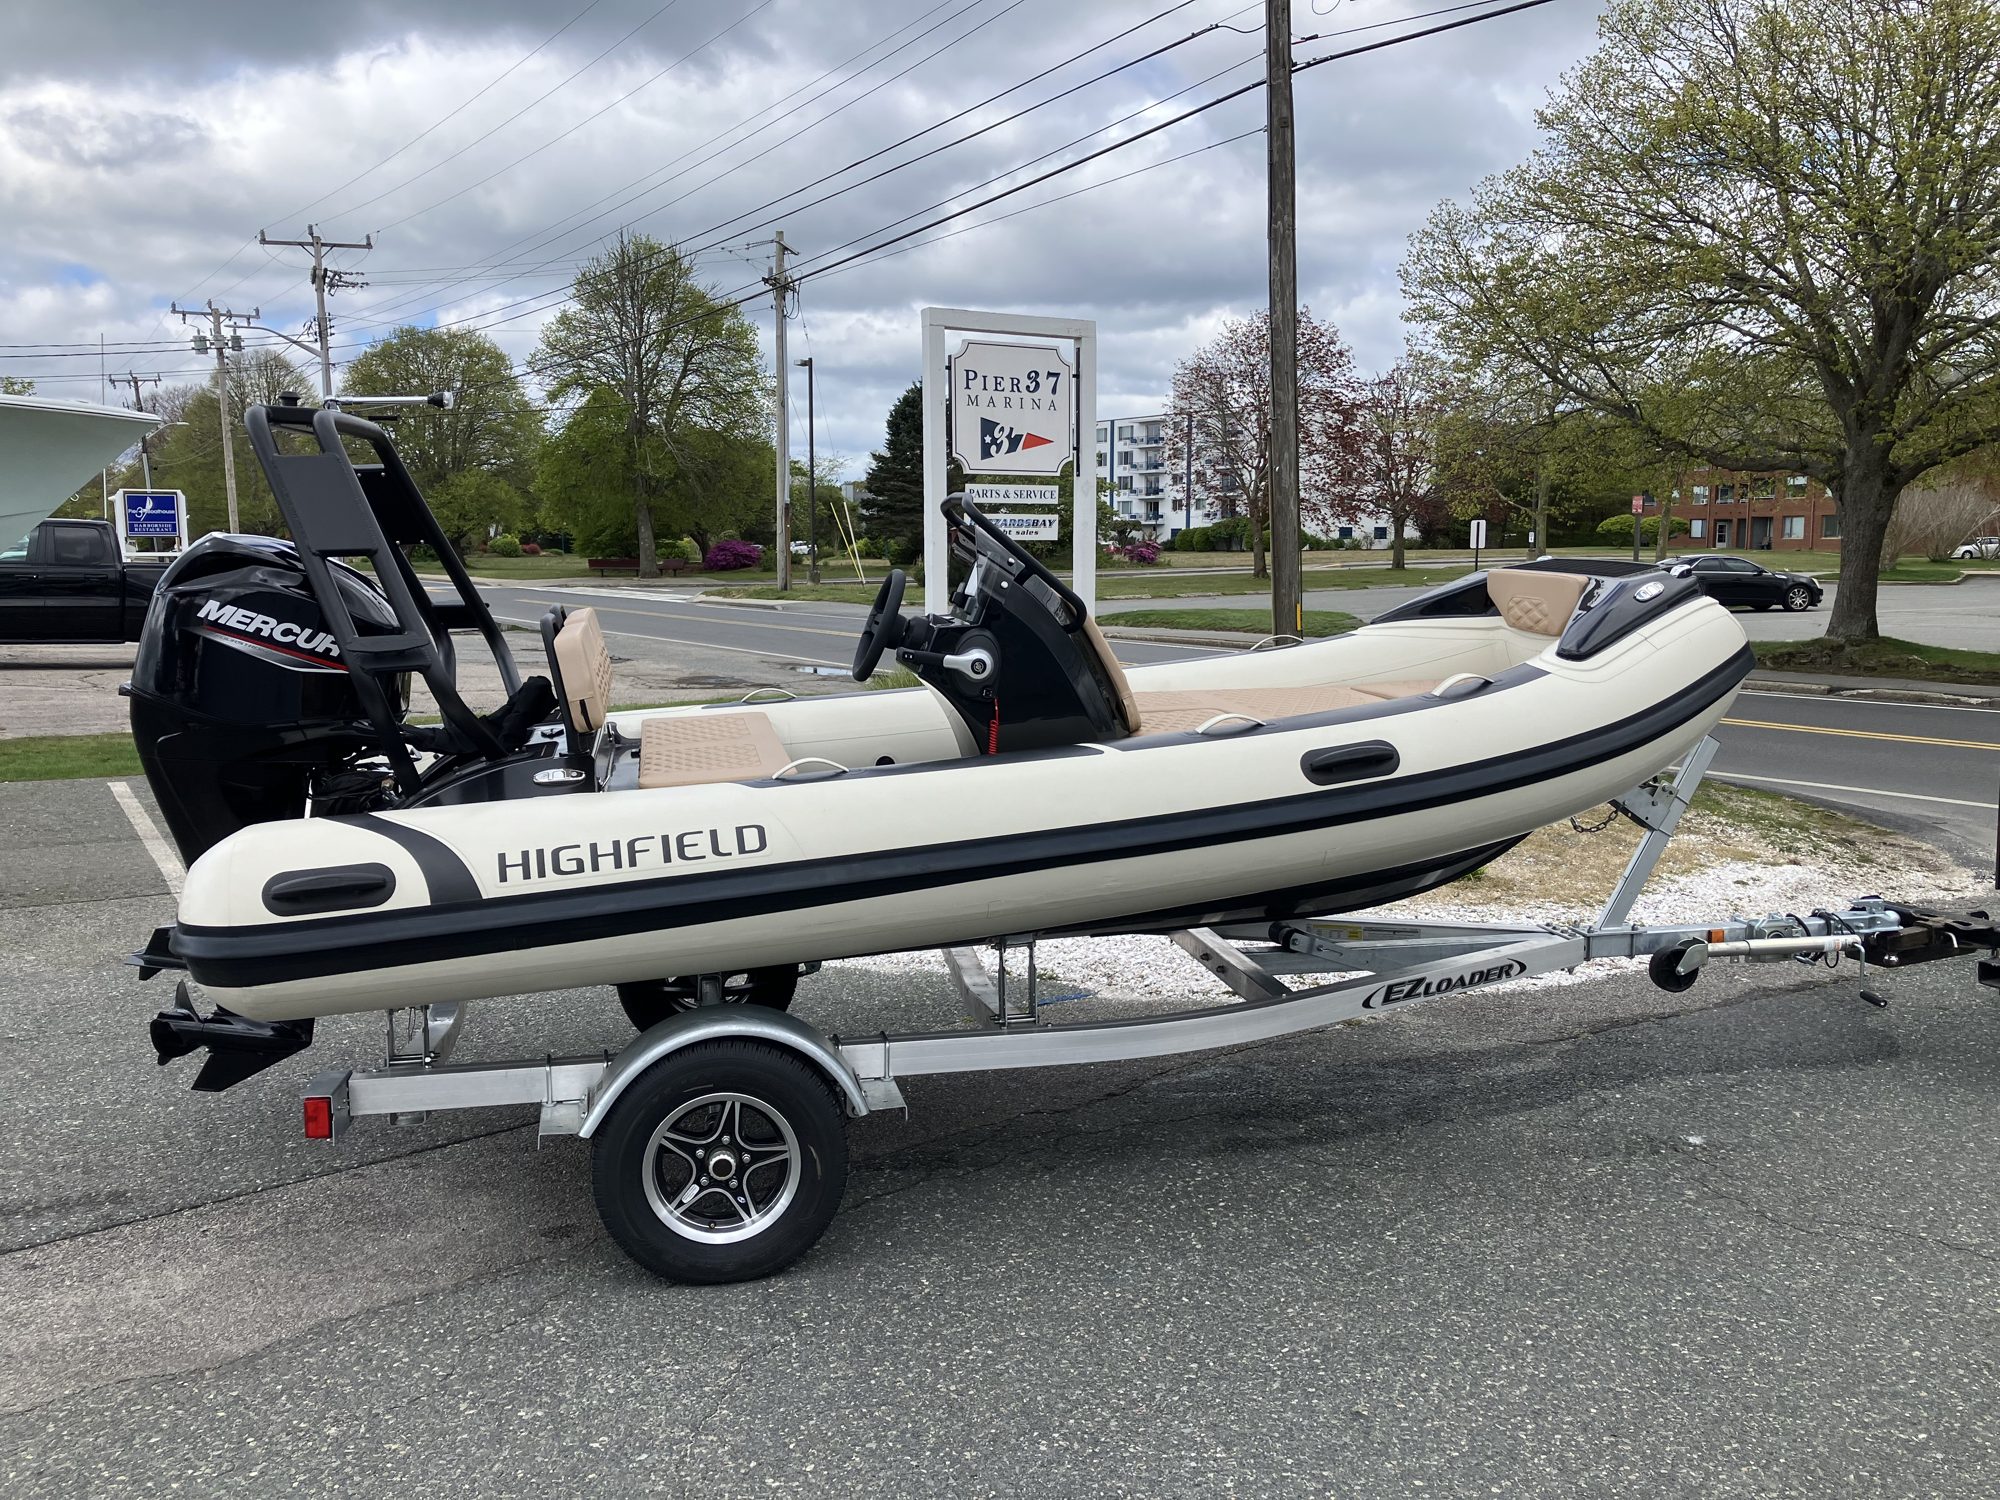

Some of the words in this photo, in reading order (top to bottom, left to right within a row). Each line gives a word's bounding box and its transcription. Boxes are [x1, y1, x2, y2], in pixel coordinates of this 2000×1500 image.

[966, 394, 1057, 411] MARINA
[969, 488, 1000, 499] PARTS
[1003, 489, 1011, 499] &
[1013, 489, 1057, 500] SERVICE
[197, 600, 341, 657] MERCUR
[497, 824, 768, 883] HIGHFIELD
